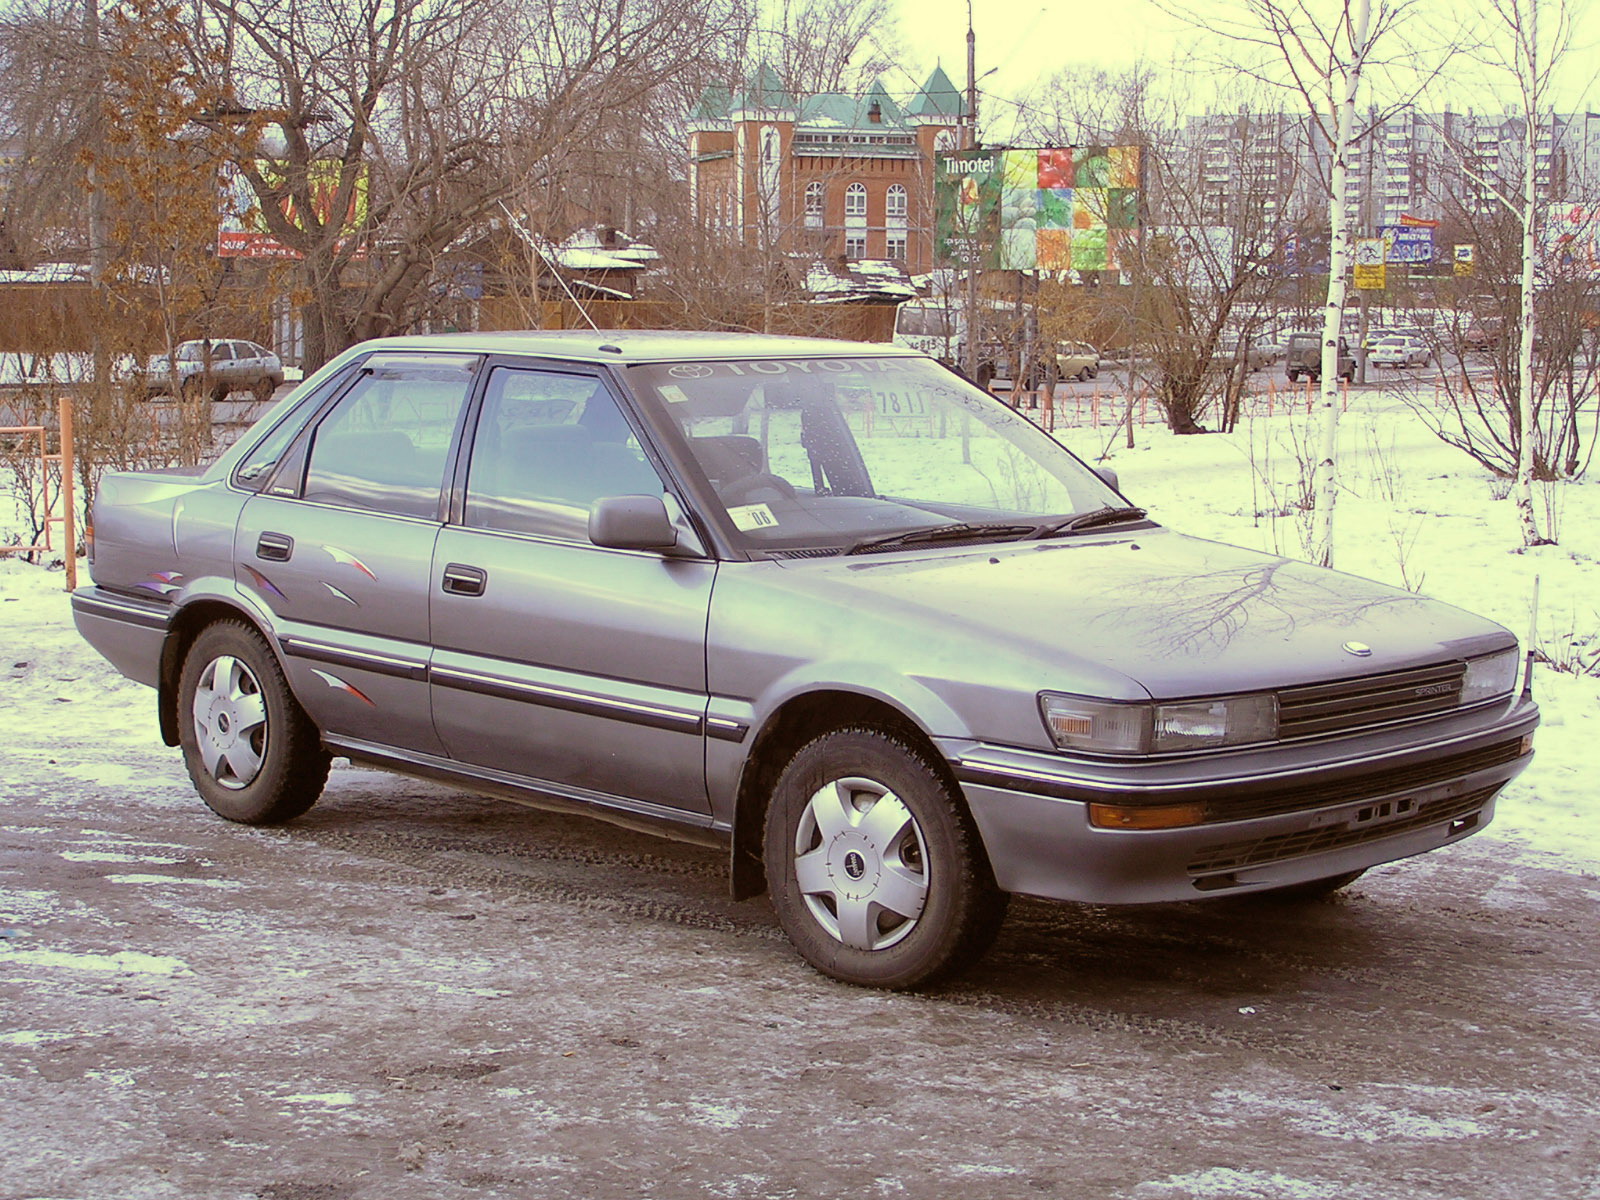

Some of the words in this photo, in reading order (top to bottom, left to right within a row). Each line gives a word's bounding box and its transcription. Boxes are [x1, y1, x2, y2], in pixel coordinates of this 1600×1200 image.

[943, 156, 994, 174] Timotei
[715, 359, 905, 376] TOYOTA
[1415, 684, 1452, 696] SPRINTER
